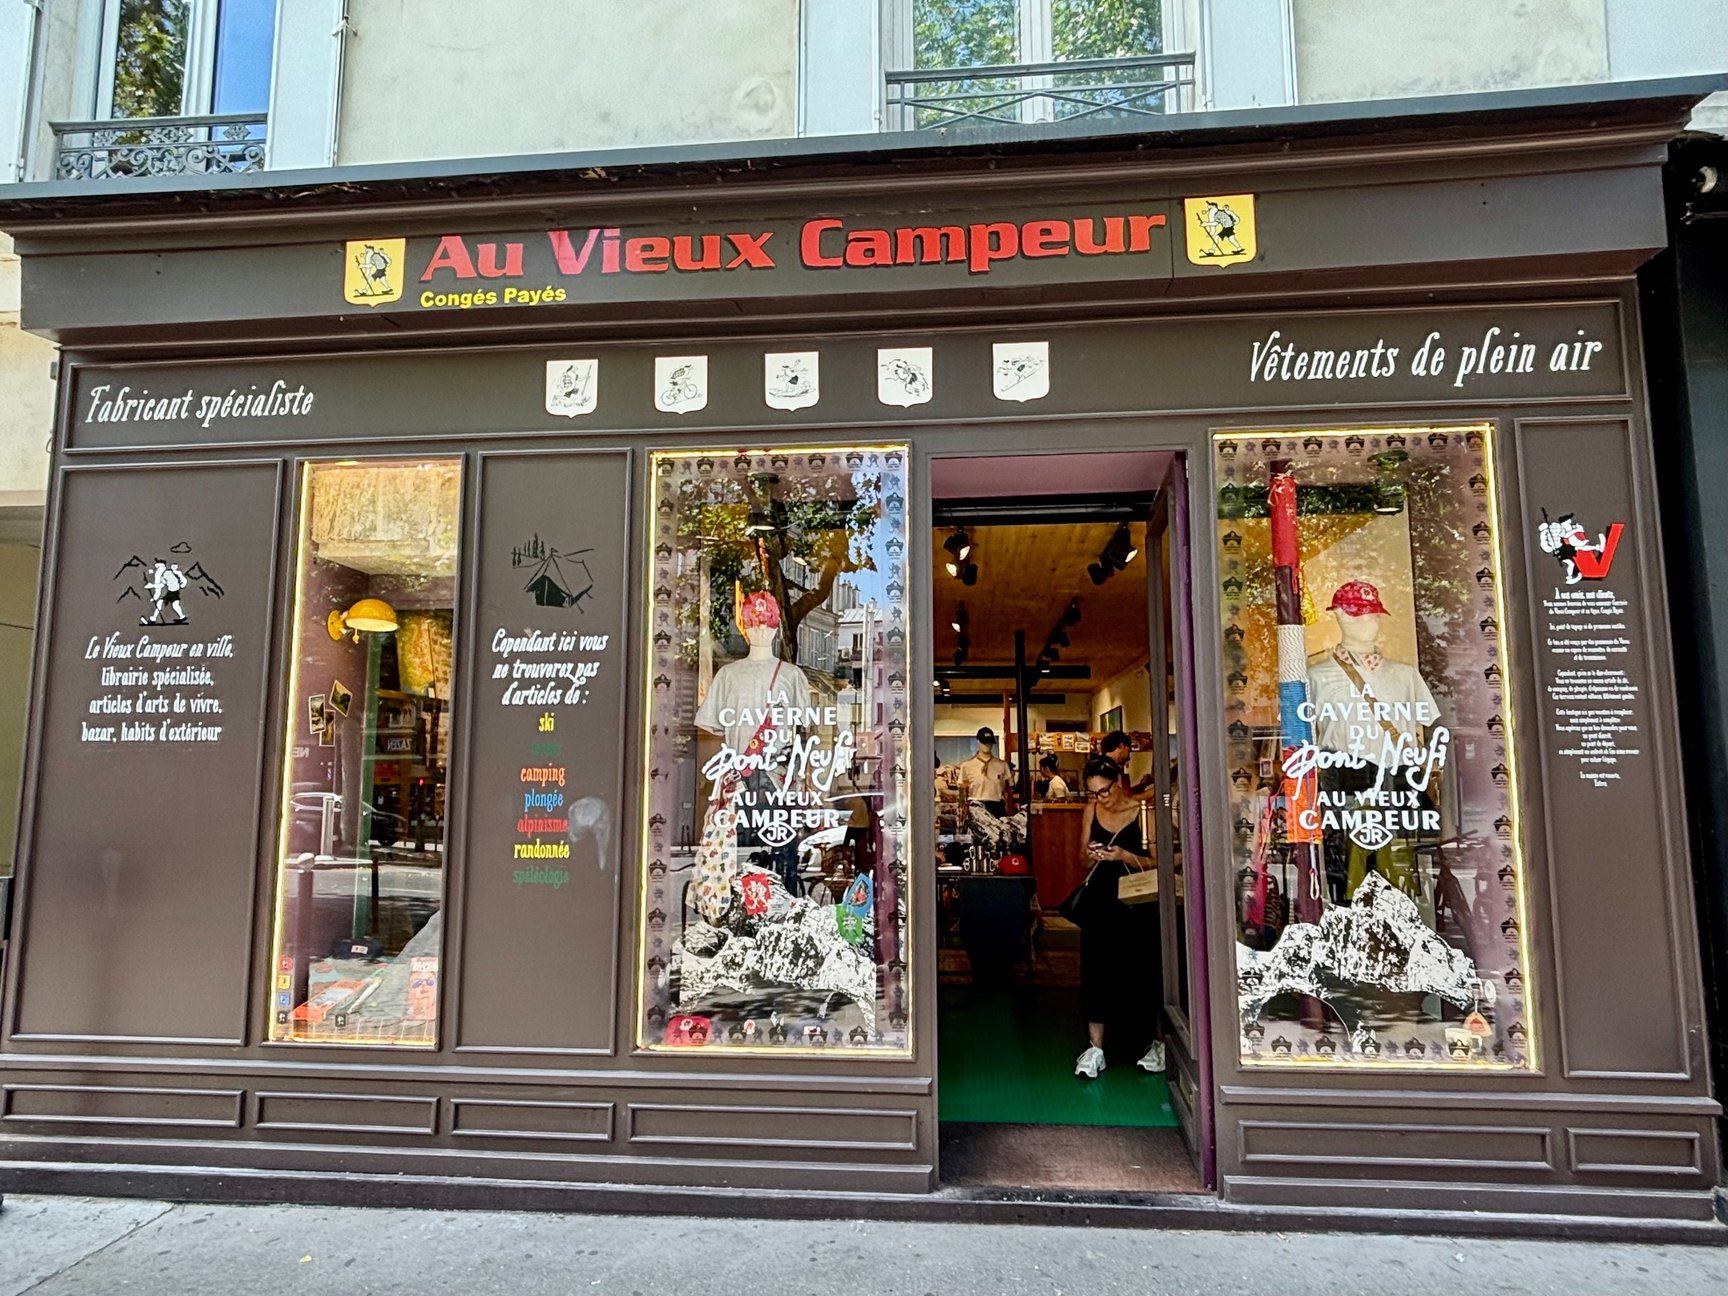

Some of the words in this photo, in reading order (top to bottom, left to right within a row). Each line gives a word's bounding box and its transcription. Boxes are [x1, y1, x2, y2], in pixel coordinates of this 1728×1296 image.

[421, 235, 525, 281] Au
[548, 226, 775, 275] Vieux
[800, 215, 1167, 272] Campeur
[420, 288, 496, 310] Congés
[503, 285, 566, 305] Payés
[1250, 331, 1399, 382] Vêtements
[1411, 332, 1444, 377] de
[1454, 327, 1536, 387] plein
[1550, 330, 1602, 372] air
[85, 384, 193, 424] Fabricant
[196, 380, 314, 428] spécialiste
[85, 636, 100, 659] Le
[103, 631, 135, 659] Vieux
[136, 635, 187, 663] Campeur
[190, 643, 203, 658] en
[492, 628, 557, 658] Cependant
[558, 631, 576, 652] ici
[579, 633, 608, 652] vous
[101, 666, 149, 687] librairie
[492, 662, 508, 679] ne
[513, 659, 586, 685] trouverez
[576, 661, 600, 681] pas
[501, 682, 562, 705] d'articles
[767, 691, 789, 704] LA
[1350, 684, 1375, 698] LA
[89, 694, 132, 714] articles
[136, 691, 169, 714] d'arts
[173, 693, 186, 714] de
[1297, 701, 1430, 722] CAVERNE
[539, 712, 555, 732] ski
[718, 707, 837, 727] CAVERNE
[121, 721, 156, 742] habits
[160, 718, 222, 742] d'extérieur
[764, 729, 790, 743] DU
[1349, 725, 1379, 739] DU
[520, 763, 566, 787] camping
[525, 789, 564, 814] plongée
[732, 792, 757, 806] AU
[765, 791, 823, 806] VIEUX
[1317, 791, 1346, 806] AU
[1355, 791, 1420, 807] VIEUX
[517, 814, 569, 839] alpinisme
[714, 809, 839, 828] CAMPEUR
[1299, 810, 1441, 830] CAMPEUR
[767, 827, 788, 841] JR
[1360, 829, 1383, 843] JR
[513, 838, 570, 860] randonnée
